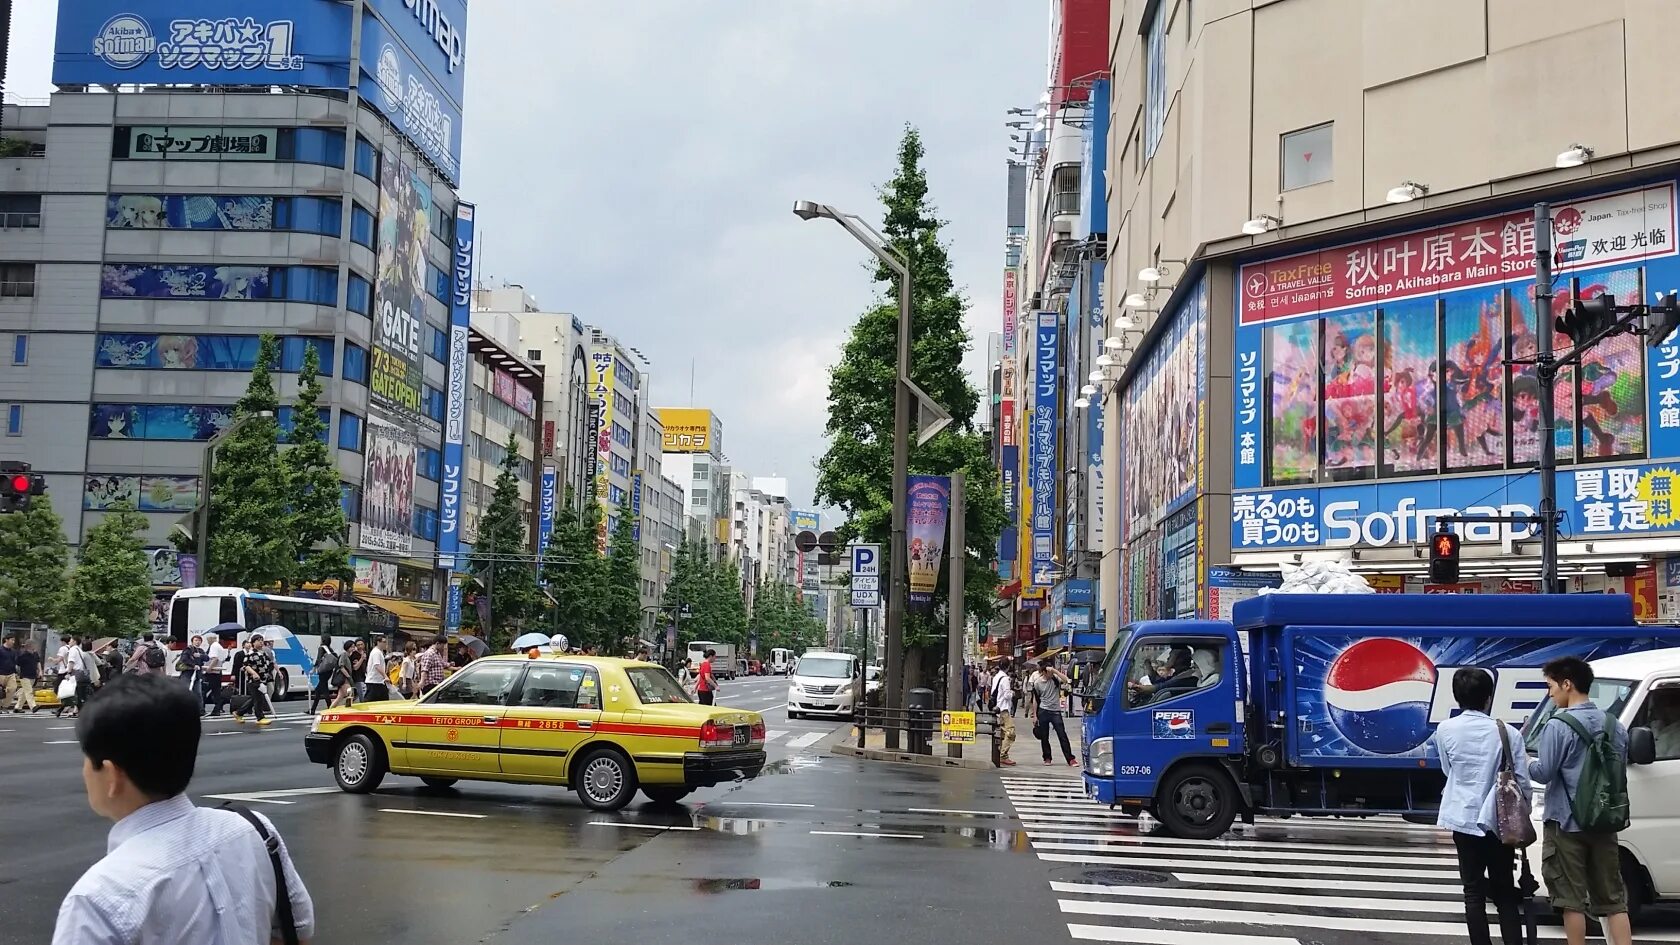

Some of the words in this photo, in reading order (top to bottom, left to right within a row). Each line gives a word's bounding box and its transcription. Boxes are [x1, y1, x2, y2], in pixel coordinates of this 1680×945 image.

[94, 36, 156, 56] Sofmap
[159, 43, 265, 68] ソフマップ
[153, 135, 250, 154] マップ劇場
[1587, 212, 1614, 222] Japan.
[1648, 203, 1668, 211] Shop
[1591, 228, 1667, 256] 欢迎光临
[453, 237, 472, 306] ソフマップ
[1277, 279, 1306, 290] TRAVEL
[1307, 274, 1333, 285] VALUE
[1345, 281, 1393, 300] Sofmap
[1395, 270, 1462, 291] Akihabara
[1465, 265, 1498, 280] Main
[1501, 258, 1537, 273] Store
[382, 300, 420, 353] GATE
[1004, 271, 1016, 352] 東京レジャーランド
[373, 346, 390, 373] 7/3
[592, 352, 612, 363] 中古
[1039, 333, 1057, 398] ソフマップ
[371, 369, 395, 399] GATE
[1240, 351, 1257, 425] ソフマップ
[589, 408, 598, 430] Mac
[1659, 387, 1680, 428] 本館
[586, 430, 598, 475] Collection
[1240, 431, 1256, 465] 本館
[1036, 405, 1055, 531] ソフマップモバイル館
[442, 464, 460, 533] ソフマップ
[1004, 470, 1013, 513] animate
[1574, 467, 1640, 502] 買取
[1650, 475, 1673, 520] 無料
[541, 480, 554, 521] ソフマップ
[1233, 493, 1315, 523] 売るのも
[1323, 497, 1538, 554] Sofmap
[1583, 500, 1650, 532] 査定
[1241, 518, 1320, 546] 買うのも
[856, 549, 874, 573] P
[374, 715, 402, 723] TAXI
[432, 717, 453, 725] TEITO
[455, 718, 482, 726] GROUP
[539, 721, 565, 729] 2858
[1155, 711, 1191, 720] PEPSI
[1121, 765, 1152, 775] 5297-06
